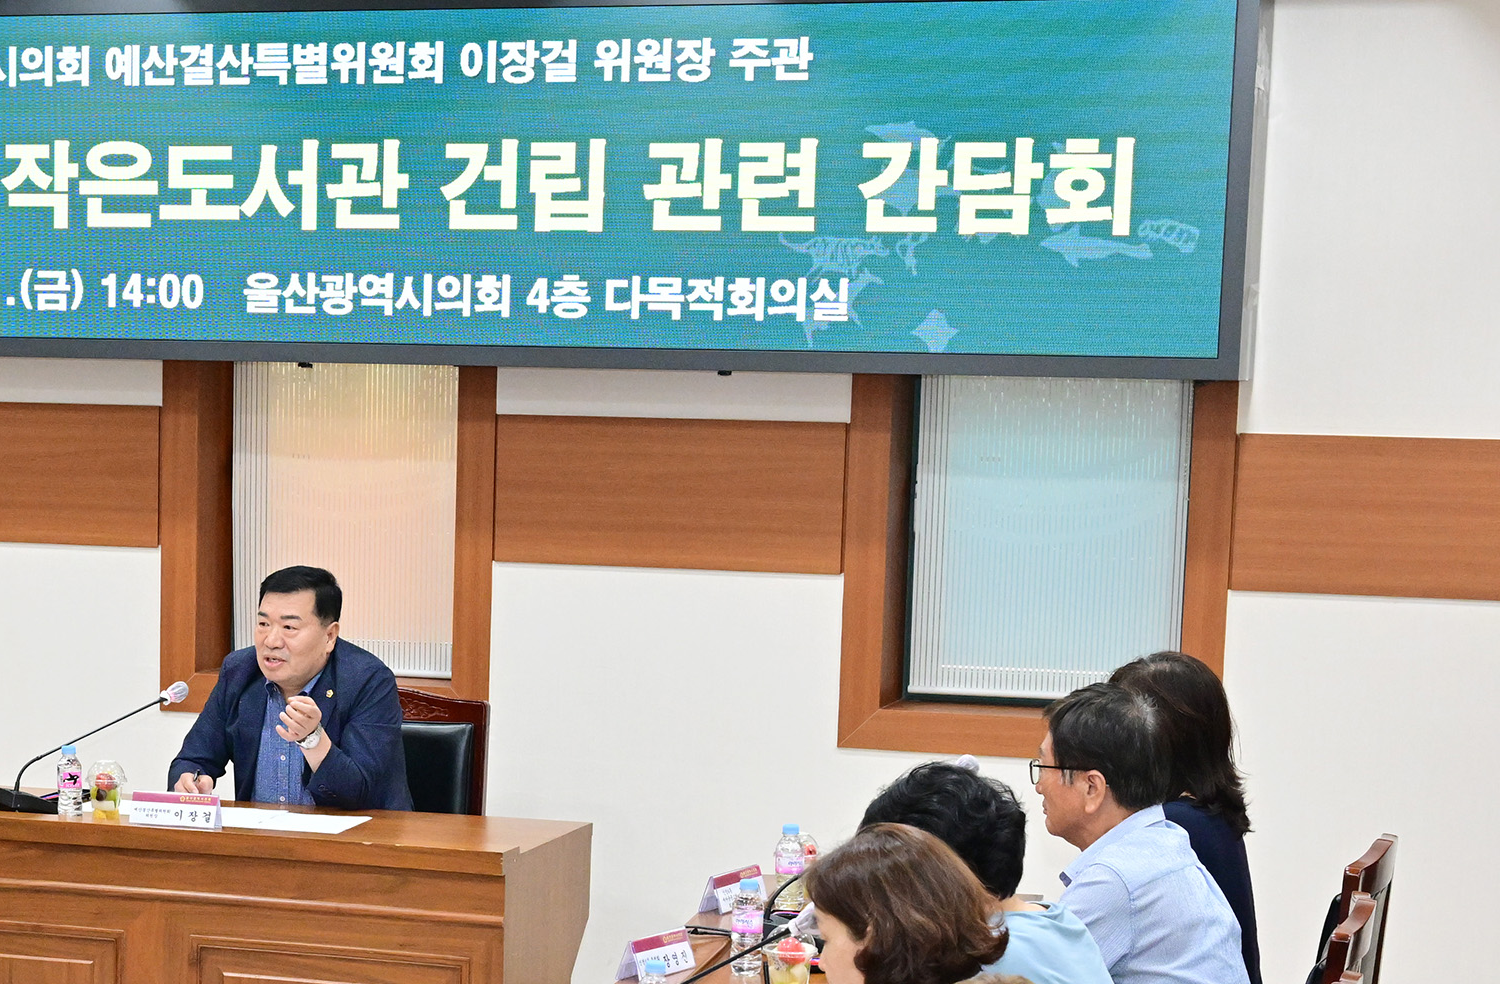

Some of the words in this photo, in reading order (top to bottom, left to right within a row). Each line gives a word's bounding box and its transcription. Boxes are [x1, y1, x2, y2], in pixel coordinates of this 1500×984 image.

[105, 41, 446, 88] 예산결산특별위원회
[460, 40, 579, 85] 이장걸
[594, 38, 717, 84] 위원장
[729, 37, 815, 83] 주관
[1, 139, 411, 233] 작은도서관
[440, 139, 609, 234] 건립
[643, 138, 821, 233] 관련
[858, 138, 1138, 237] 간담회
[102, 274, 206, 310] 14:00
[243, 273, 513, 319] 울산광역시의회
[526, 275, 593, 320] 4층
[605, 276, 852, 323] 다목적회의실
